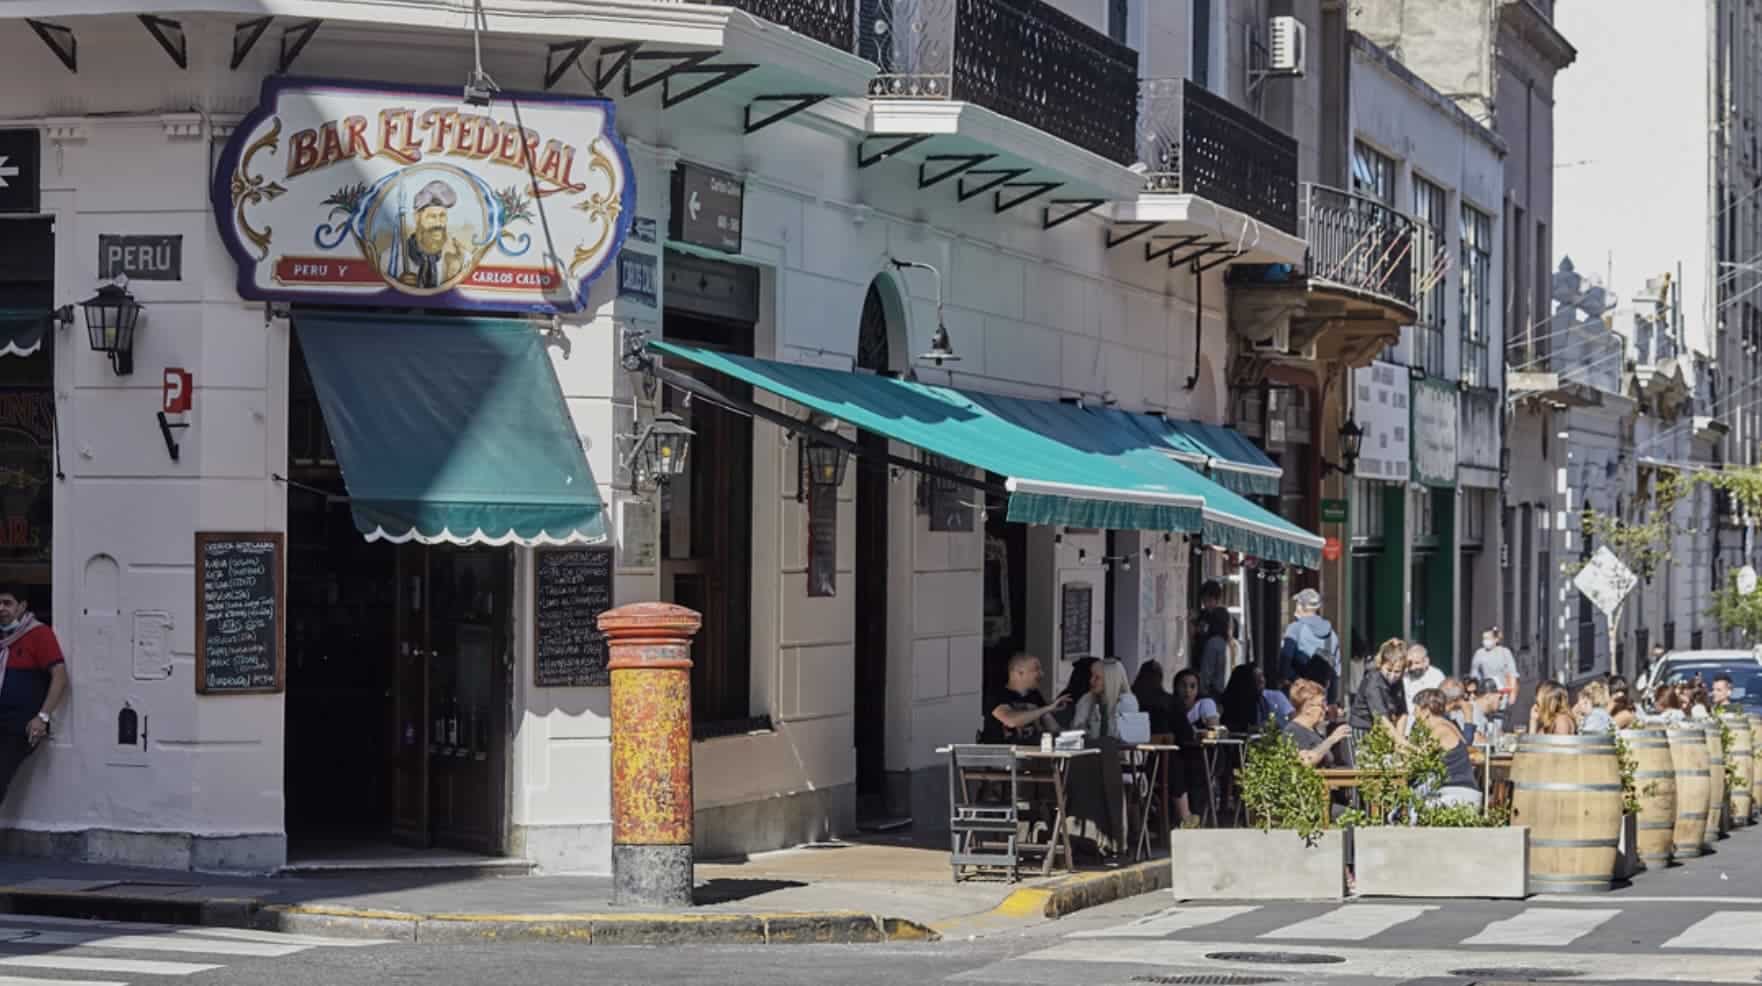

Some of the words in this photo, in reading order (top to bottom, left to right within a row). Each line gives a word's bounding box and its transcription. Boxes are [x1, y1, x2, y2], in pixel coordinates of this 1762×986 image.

[286, 115, 376, 178] BAR
[377, 106, 423, 165] EL
[417, 107, 586, 197] FEDERAL
[108, 239, 171, 271] PERÚ
[293, 263, 328, 277] PERU
[338, 264, 349, 277] Y
[472, 270, 513, 285] CARLOS
[515, 272, 551, 286] CALVO
